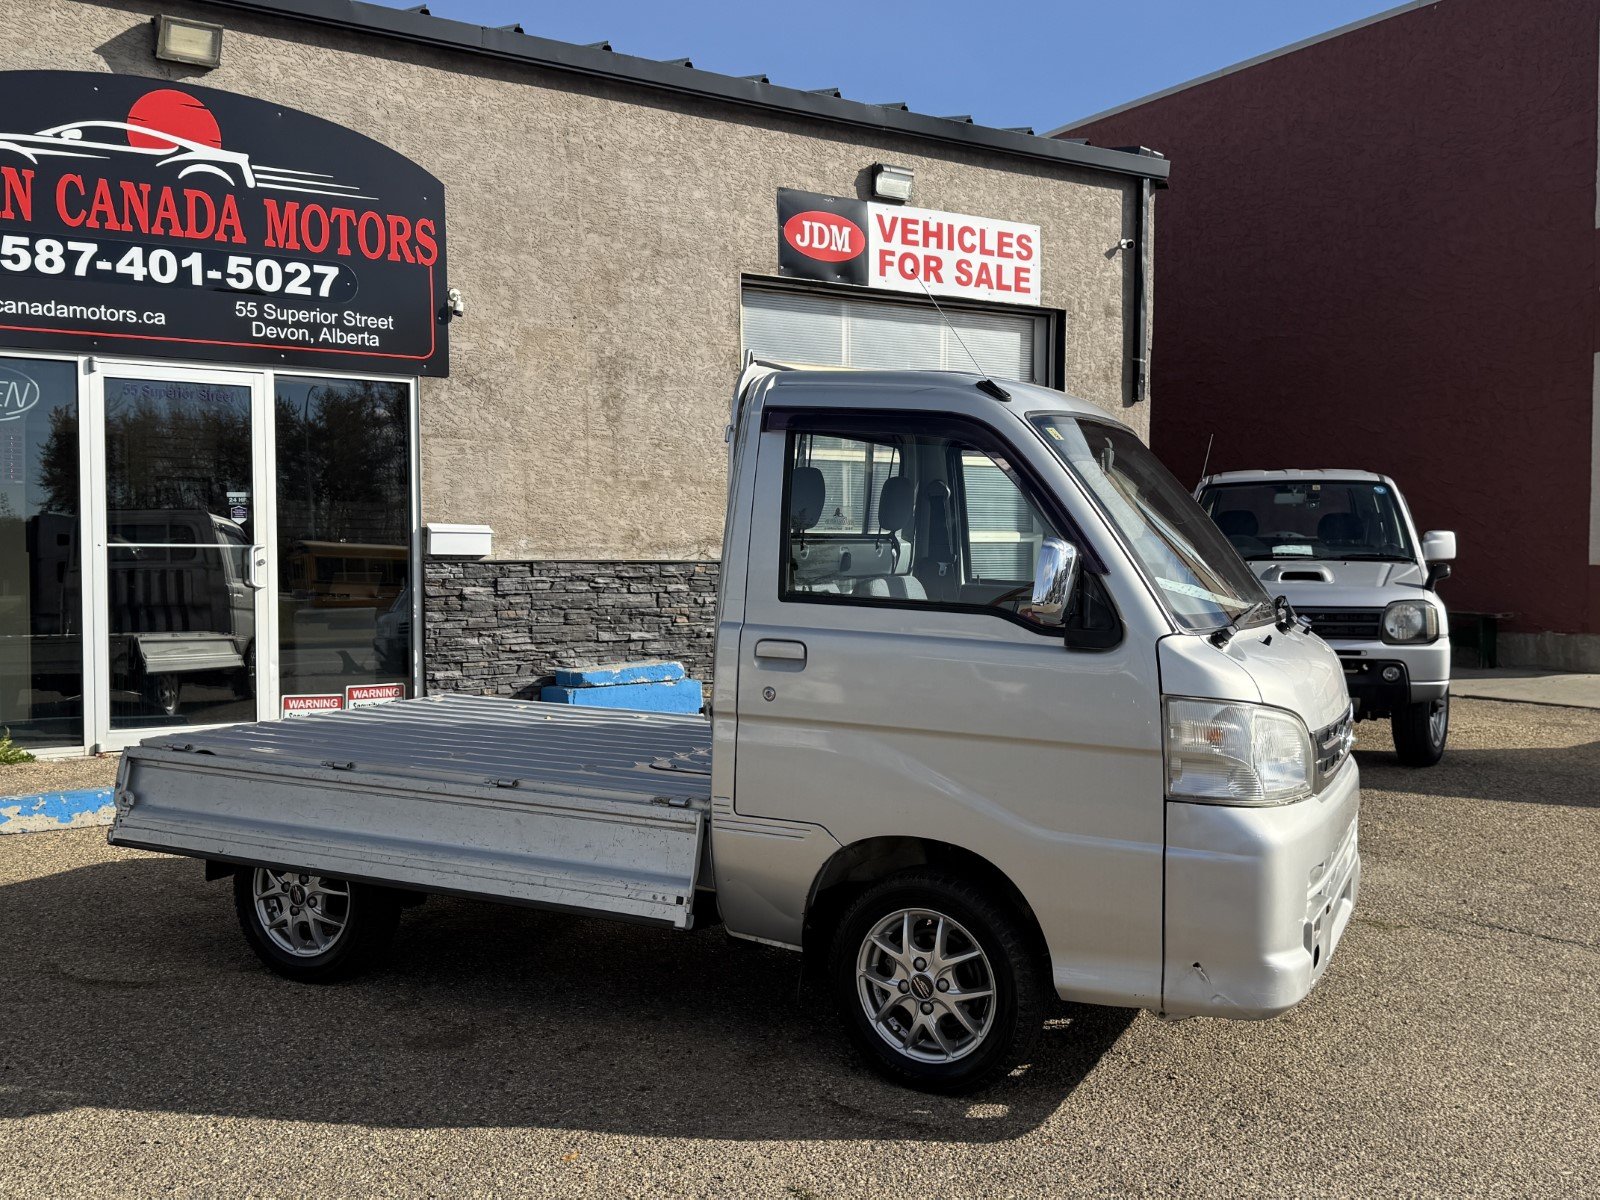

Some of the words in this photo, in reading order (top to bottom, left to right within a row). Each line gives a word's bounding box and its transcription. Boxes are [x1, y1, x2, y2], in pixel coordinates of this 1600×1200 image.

[0, 166, 35, 222] N
[55, 173, 247, 244] CANADA
[264, 199, 438, 267] MOTORS
[795, 220, 852, 253] JDM
[876, 213, 1034, 261] VEHICLES
[0, 235, 340, 298] 587-401-5027
[879, 248, 943, 284] FOR
[955, 259, 1031, 294] SALE
[235, 301, 258, 318] 55
[263, 303, 338, 325] Superior
[343, 310, 394, 330] Street
[252, 321, 314, 344] Devon,
[319, 327, 380, 347] Alberta
[122, 382, 138, 396] 55
[141, 384, 194, 402] Superior
[199, 389, 234, 403] Street
[288, 698, 338, 709] WARNING
[353, 688, 400, 698] WARNING
